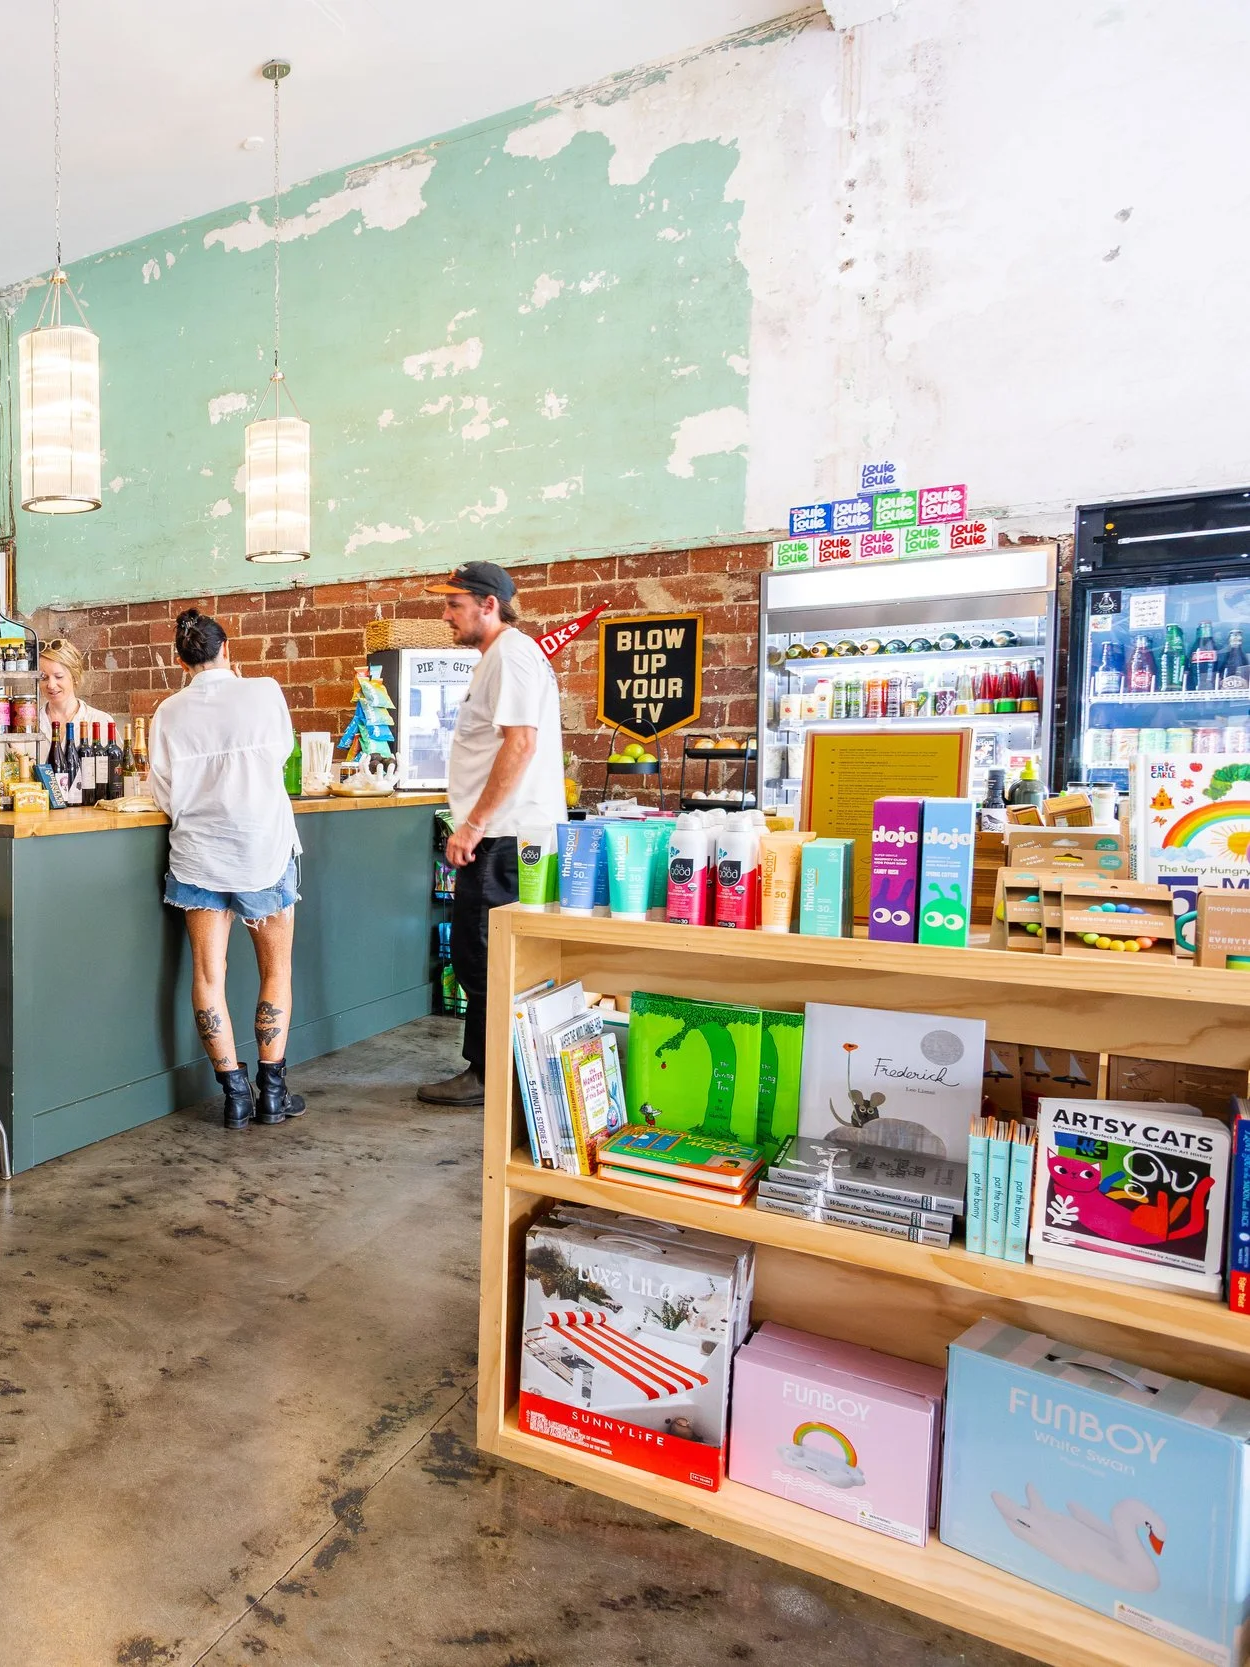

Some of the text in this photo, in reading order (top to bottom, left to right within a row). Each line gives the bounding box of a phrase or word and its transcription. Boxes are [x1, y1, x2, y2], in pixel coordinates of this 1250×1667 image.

[862, 461, 896, 477] Louie
[862, 473, 895, 489] Louie
[875, 493, 915, 512] Louie
[921, 487, 963, 506] Louie
[833, 499, 871, 517] Louie
[875, 507, 915, 525] Louie
[921, 500, 962, 519] Louie
[793, 517, 826, 533] Louie
[833, 512, 871, 530] Louie
[950, 521, 987, 538] Louie
[819, 536, 852, 551] Louie
[860, 530, 894, 546] Louie
[905, 526, 940, 542] Louie
[950, 533, 987, 549] Louie
[778, 540, 809, 555] Louie
[819, 548, 851, 563] Louie
[860, 542, 894, 558] Louie
[905, 538, 940, 554] Louie
[778, 552, 809, 566] Louie
[616, 628, 685, 651] BLOW
[416, 661, 434, 673] PIE
[633, 653, 667, 675] UP
[616, 678, 683, 699] YOUR
[633, 703, 664, 723] TV
[1151, 763, 1175, 772] ERIC
[872, 825, 918, 848] dojo
[923, 827, 971, 850] dojo
[562, 828, 576, 877] thinksport
[573, 871, 584, 879] 50
[670, 867, 690, 877] good
[763, 849, 776, 897] thinkbaby
[1158, 864, 1178, 872] The
[1181, 866, 1207, 874] Very
[774, 891, 787, 899] 50
[804, 868, 815, 912] thinkkids
[874, 1057, 960, 1087] Frederick
[529, 1081, 548, 1145] 5-MINUTE STORIES
[1052, 1109, 1214, 1153] ARTSY CATS
[686, 1141, 747, 1155] MOON
[1058, 1125, 1089, 1136] Pawsitively
[1089, 1131, 1113, 1141] Purrfect
[1128, 1139, 1153, 1148] Through
[1154, 1144, 1177, 1153] Modern
[1190, 1151, 1213, 1161] History
[777, 1172, 921, 1204] Silverstein Where the Sidewalk Ends
[971, 1173, 983, 1220] pat the bunny
[767, 1187, 910, 1221] Silverstein Where the Sidewalk Ends
[991, 1177, 1003, 1224] pat the bunny
[1012, 1181, 1025, 1228] pat the bunny
[765, 1201, 907, 1237] Silverstein Where the Sidewalk Ends
[577, 1263, 674, 1301] LUXE LILO
[1034, 1430, 1081, 1457] White
[1086, 1449, 1135, 1477] Swan
